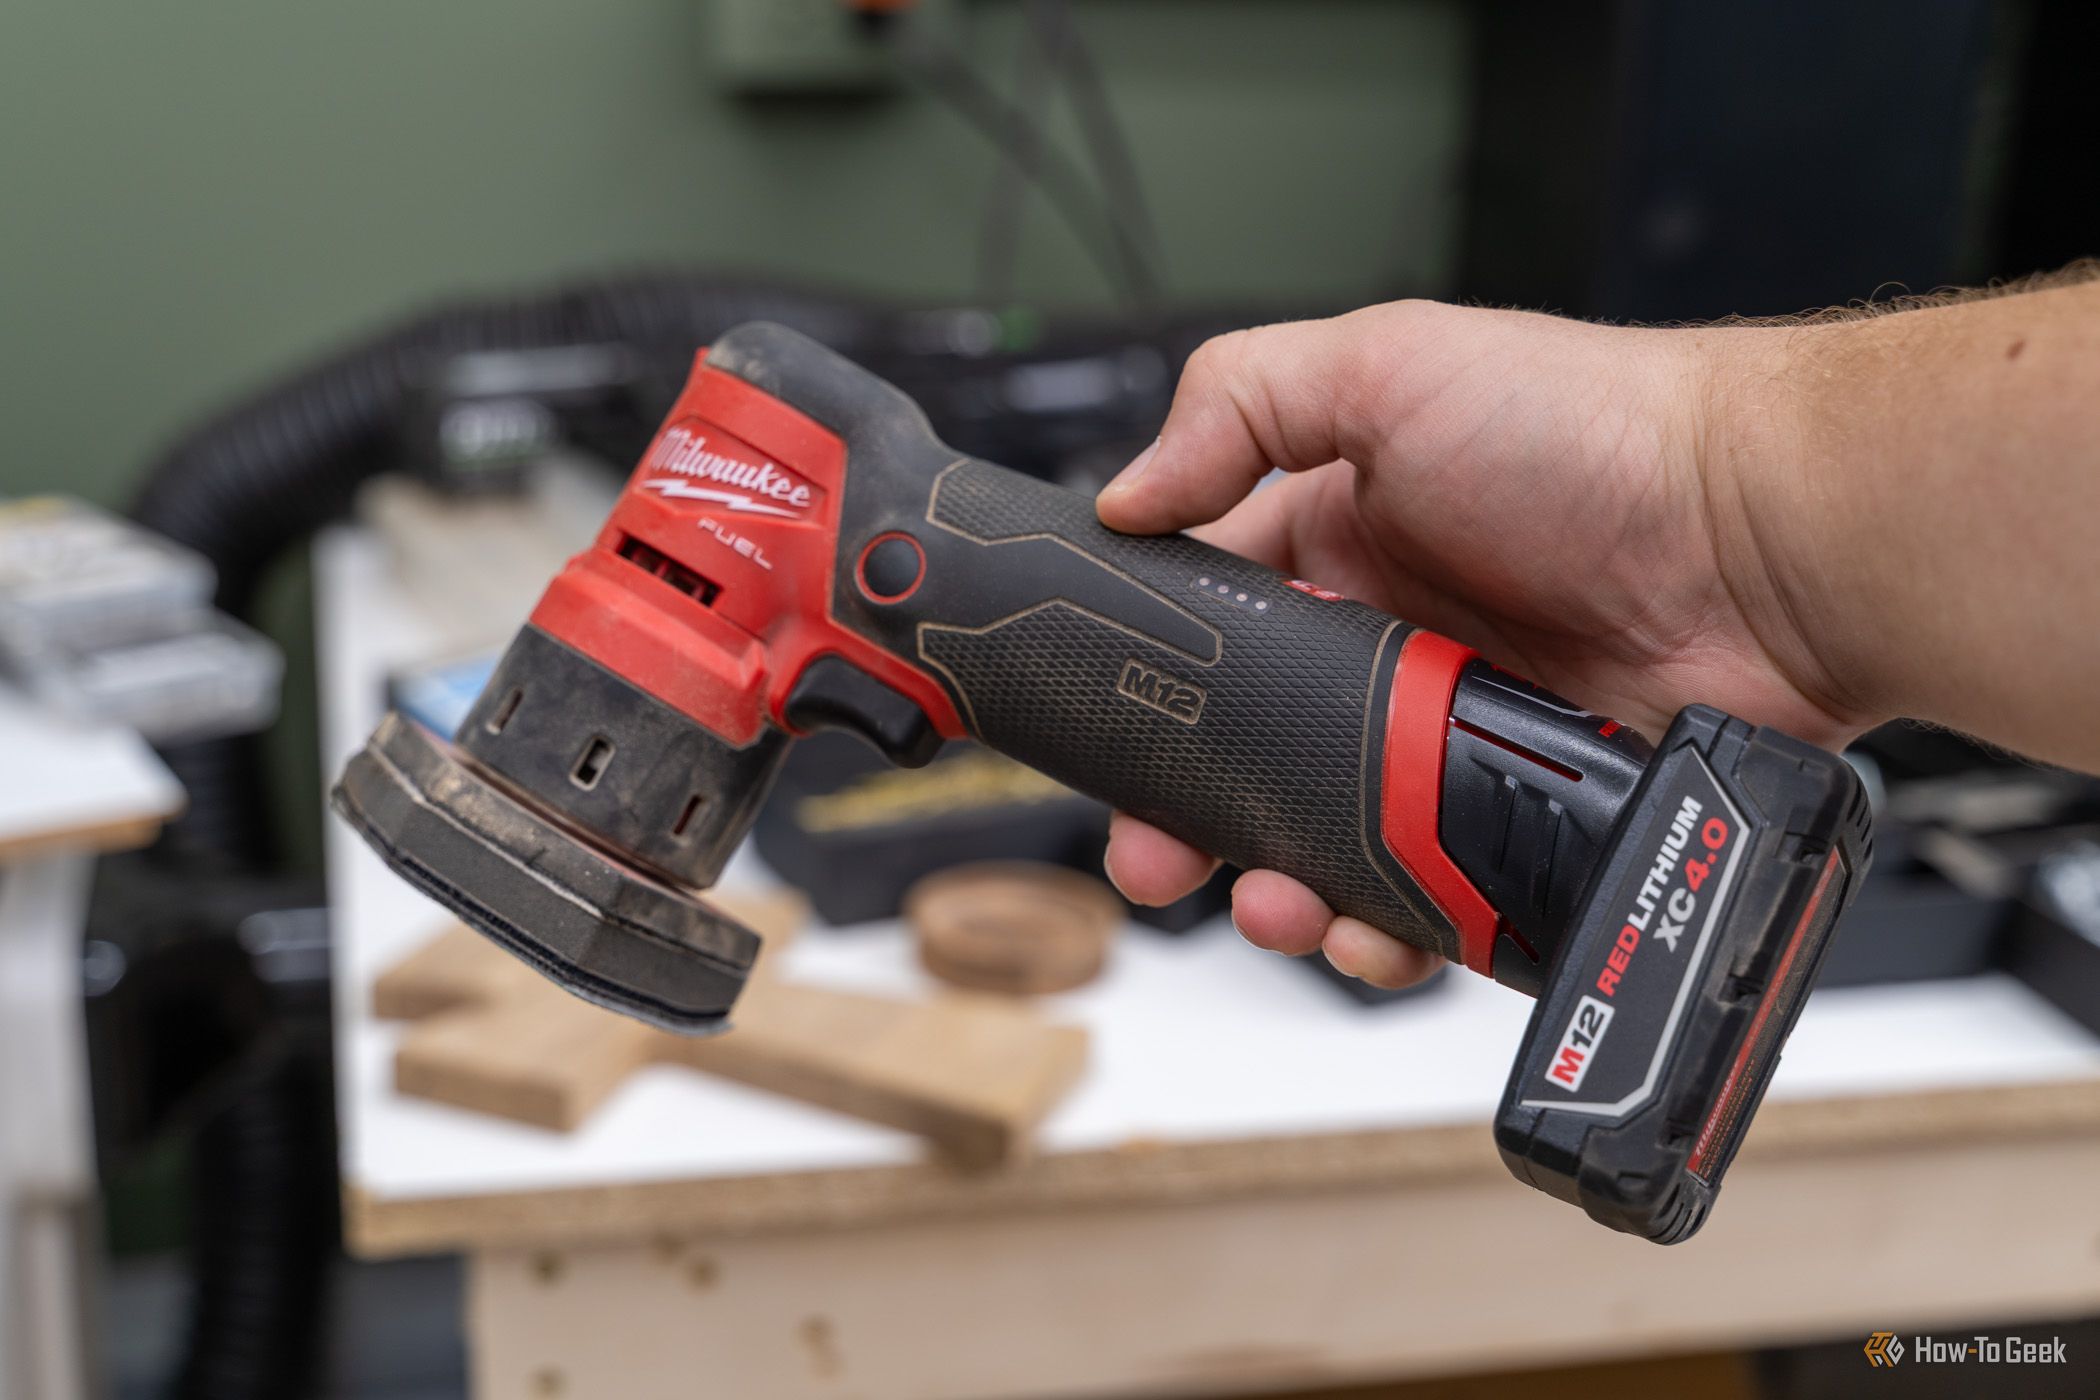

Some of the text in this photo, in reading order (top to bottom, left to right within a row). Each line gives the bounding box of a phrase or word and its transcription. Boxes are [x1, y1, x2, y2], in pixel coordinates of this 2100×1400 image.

[652, 426, 811, 508] Milwaukee
[697, 517, 773, 570] FUEL
[1123, 666, 1200, 716] M12
[1653, 817, 1728, 952] XC4.0
[1551, 796, 1703, 1084] M12 REDLITHIUM
